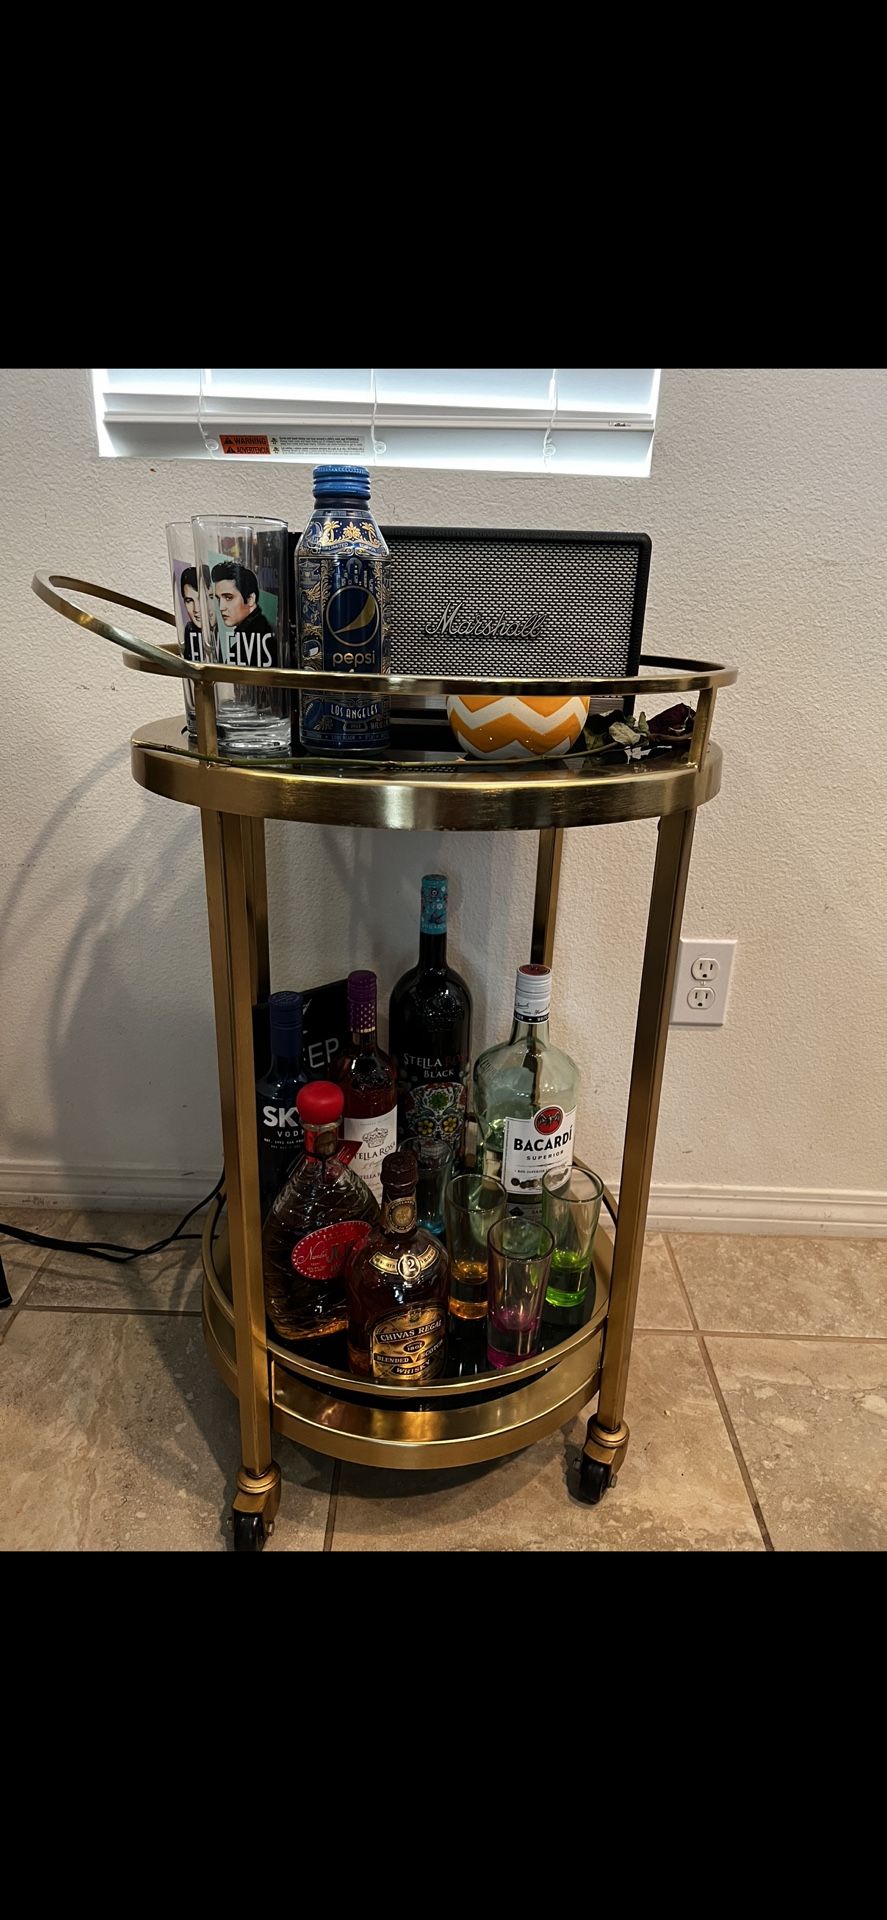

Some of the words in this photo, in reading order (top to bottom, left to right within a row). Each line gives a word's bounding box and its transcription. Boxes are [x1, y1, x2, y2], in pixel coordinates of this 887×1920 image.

[234, 436, 267, 445] WARNING
[425, 601, 548, 637] Marshall
[226, 631, 272, 668] ELVIS
[332, 650, 376, 668] pepsi
[330, 703, 344, 717] LOS
[345, 703, 378, 719] ANGELES
[403, 1052, 442, 1070] STELLA
[423, 1068, 455, 1079] BLACK
[262, 1105, 300, 1128] SK
[353, 1150, 378, 1161] TELLA
[526, 1149, 565, 1161] SUPERIOR
[380, 1329, 416, 1341] CHIVAS
[376, 1355, 410, 1364] BLENDED
[396, 1359, 431, 1375] WHISKY
